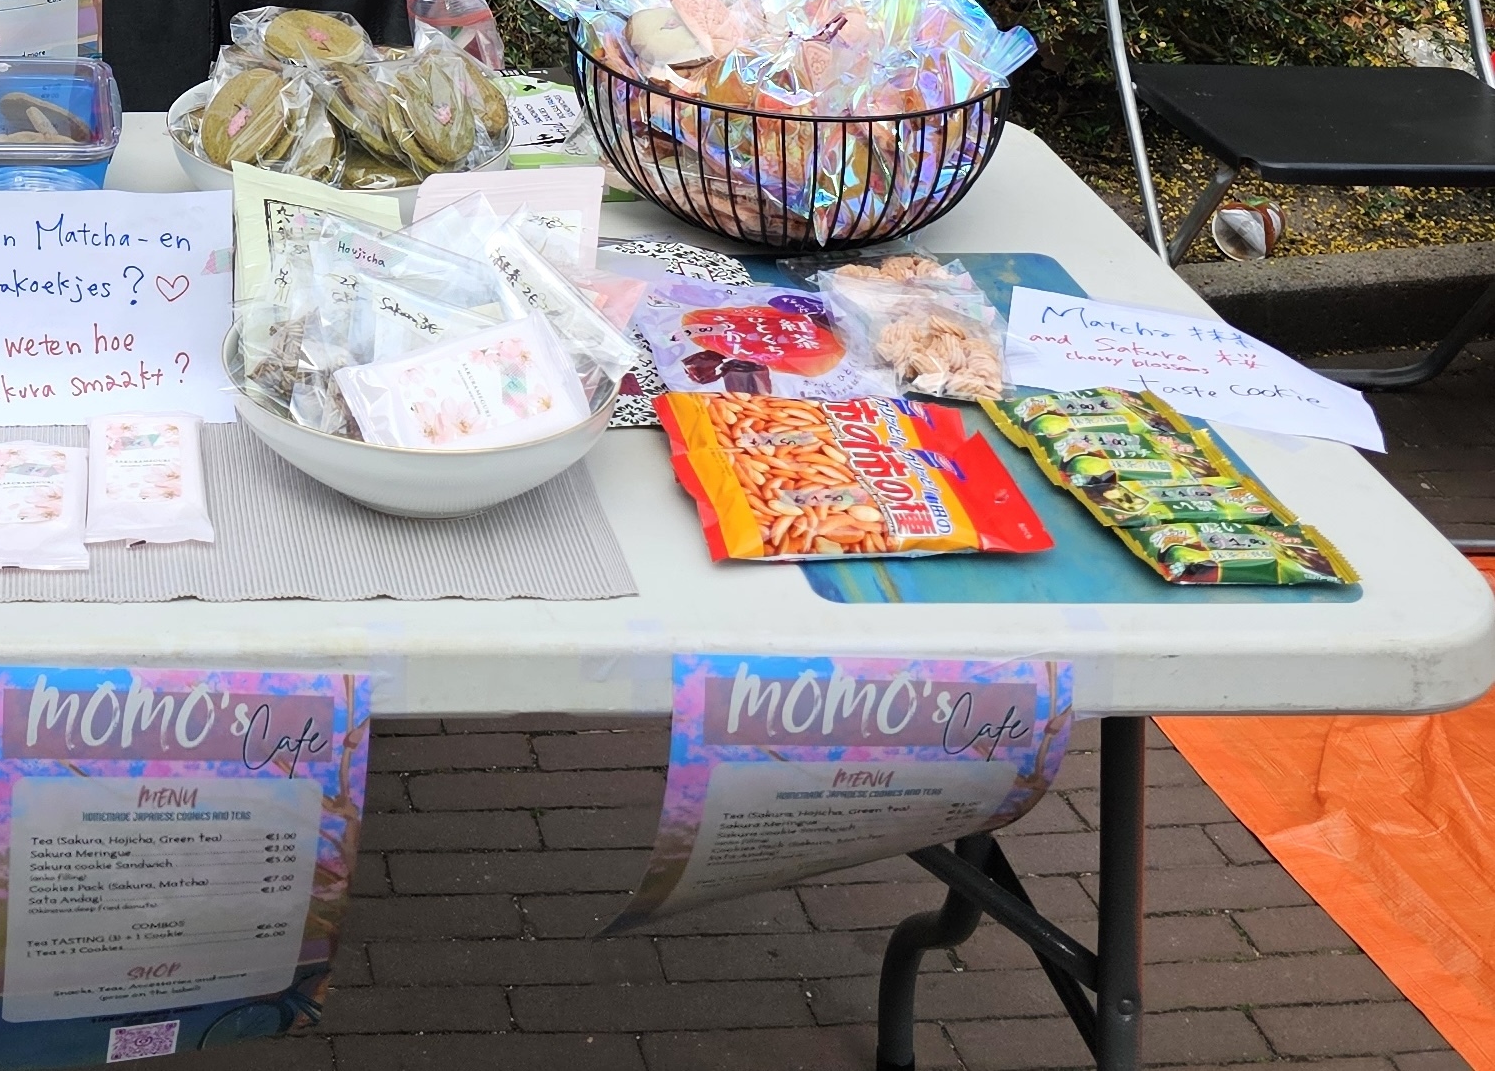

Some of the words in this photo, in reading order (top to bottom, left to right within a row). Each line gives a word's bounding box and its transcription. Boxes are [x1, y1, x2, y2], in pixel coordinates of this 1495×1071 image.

[338, 241, 386, 268] Houjicha
[1042, 307, 1175, 337] Matcha
[6, 334, 81, 356] weten
[93, 323, 134, 354] hoe
[779, 318, 820, 350] 紅茶
[1029, 333, 1071, 346] and
[1096, 338, 1191, 361] Sakura
[836, 438, 937, 535] 柿の種
[727, 661, 953, 737] MOMO's
[26, 674, 250, 751] MOMO's
[833, 768, 895, 788] MENU
[138, 785, 198, 808] MENU
[31, 837, 52, 845] Tea
[160, 835, 194, 843] Green
[199, 833, 223, 842] tea)
[30, 863, 71, 871] Sakura
[74, 862, 111, 870] cookie
[115, 859, 173, 869] Sandwich
[31, 849, 72, 858] Sakura
[76, 849, 131, 859] Meringue
[29, 884, 74, 893] Cookies
[78, 882, 104, 891] Pack
[159, 878, 209, 888] Matcha)
[28, 896, 56, 904] Sata
[60, 895, 102, 904] Andagi
[52, 937, 104, 945] TASTING
[127, 962, 181, 980] SHOP
